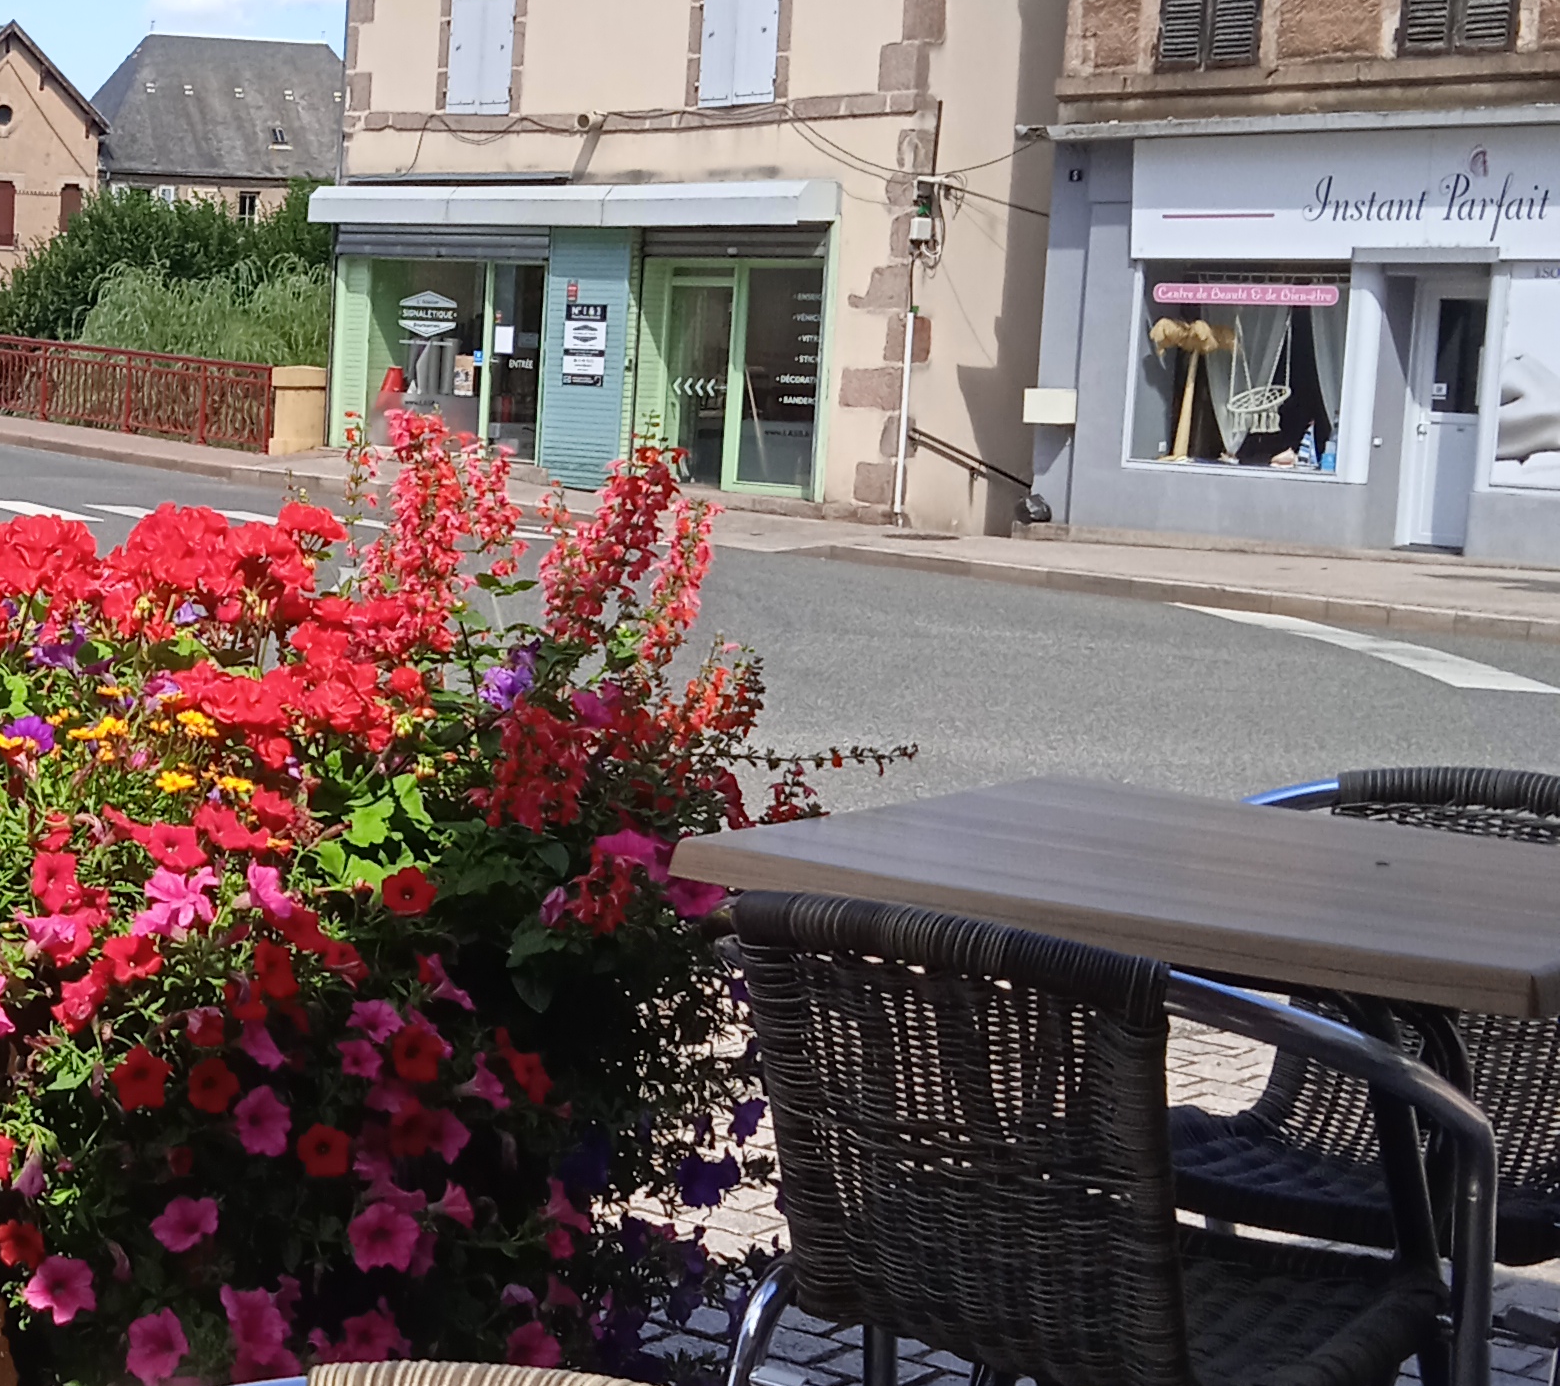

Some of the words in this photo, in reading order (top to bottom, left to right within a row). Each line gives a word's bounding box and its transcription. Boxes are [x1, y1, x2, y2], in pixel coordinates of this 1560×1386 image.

[1302, 174, 1430, 222] Instant
[1439, 172, 1550, 242] Parfait
[1158, 286, 1194, 299] Centre
[1196, 287, 1208, 300] de
[1211, 287, 1247, 300] Beauté
[1265, 288, 1277, 301] de
[1280, 287, 1332, 302] Bien-être
[508, 358, 534, 370] ENTRÉE
